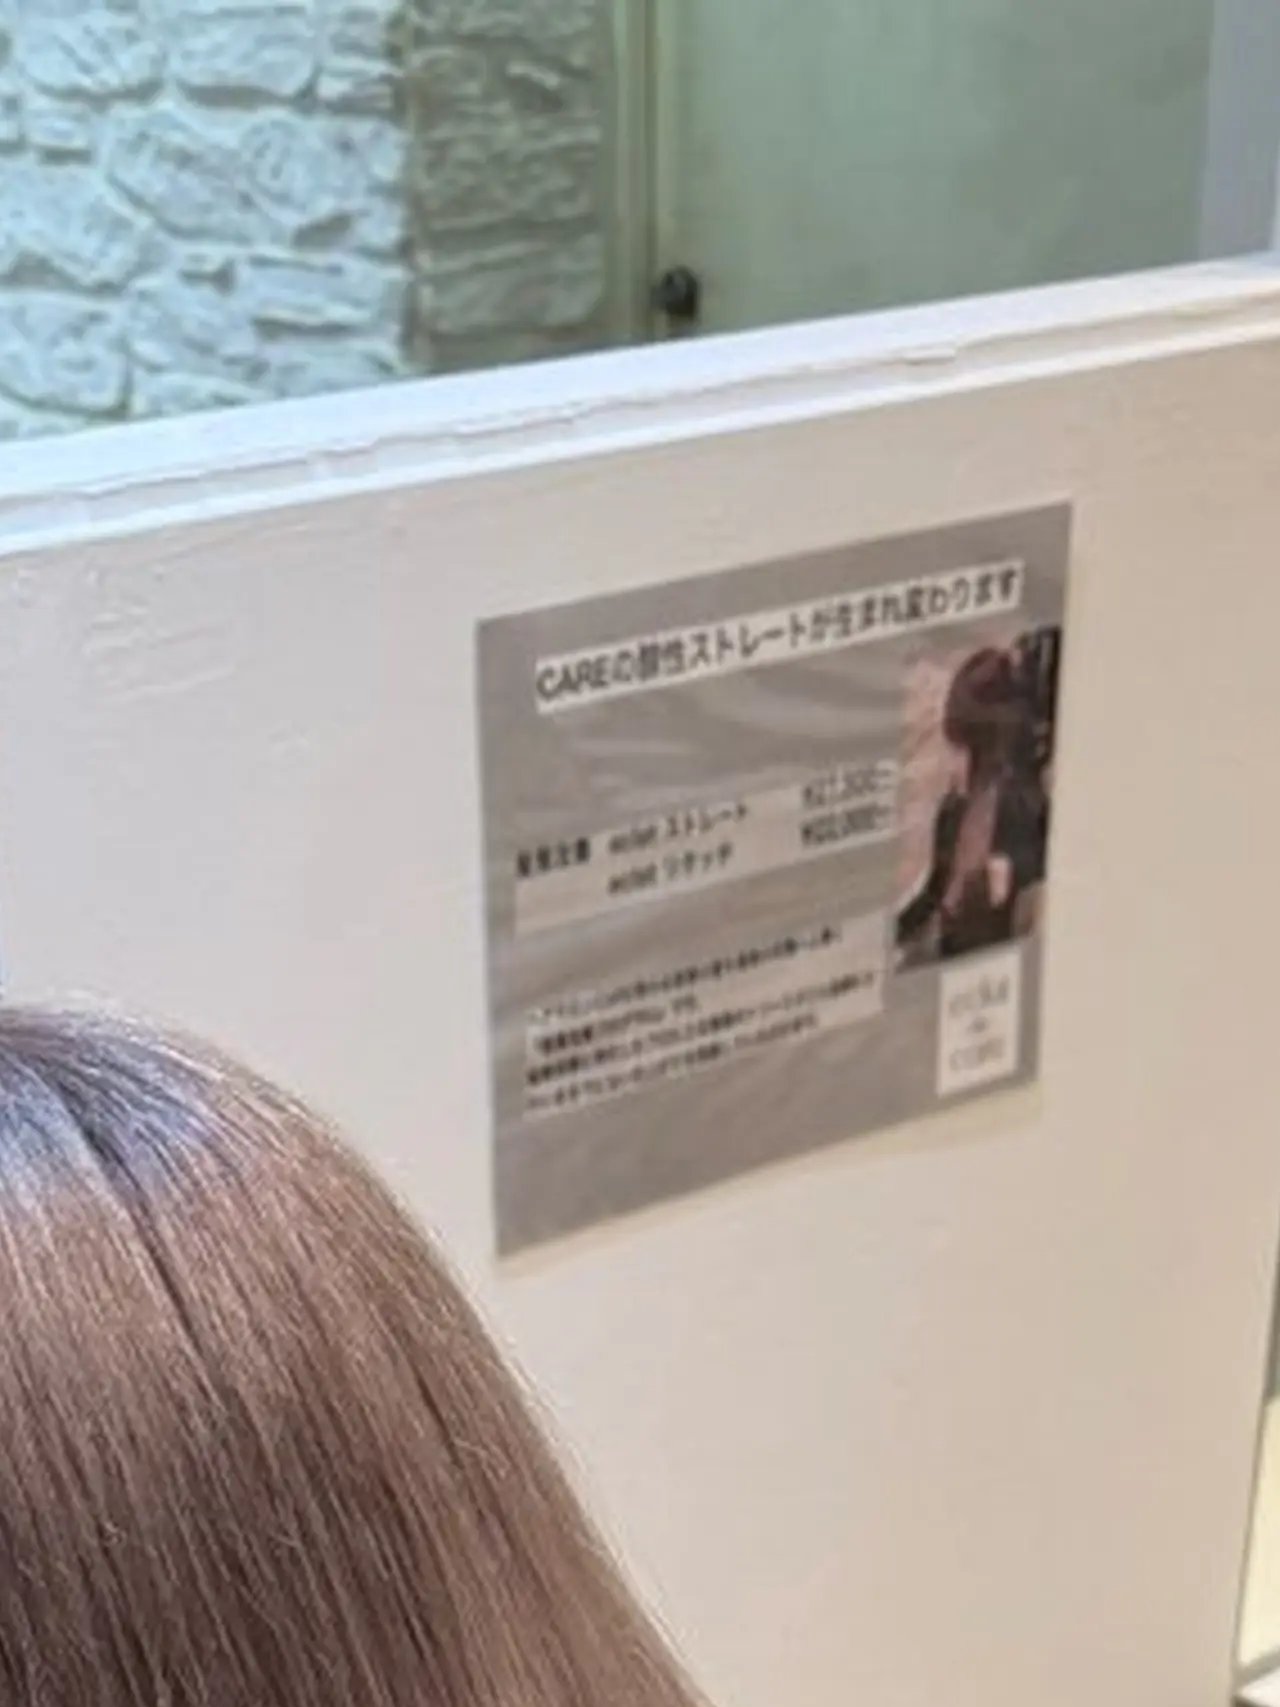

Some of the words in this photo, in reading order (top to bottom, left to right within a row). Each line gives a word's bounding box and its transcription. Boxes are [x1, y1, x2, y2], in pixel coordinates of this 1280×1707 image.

[535, 567, 1018, 701] CAREの酸性ストレートが生まれ変わります
